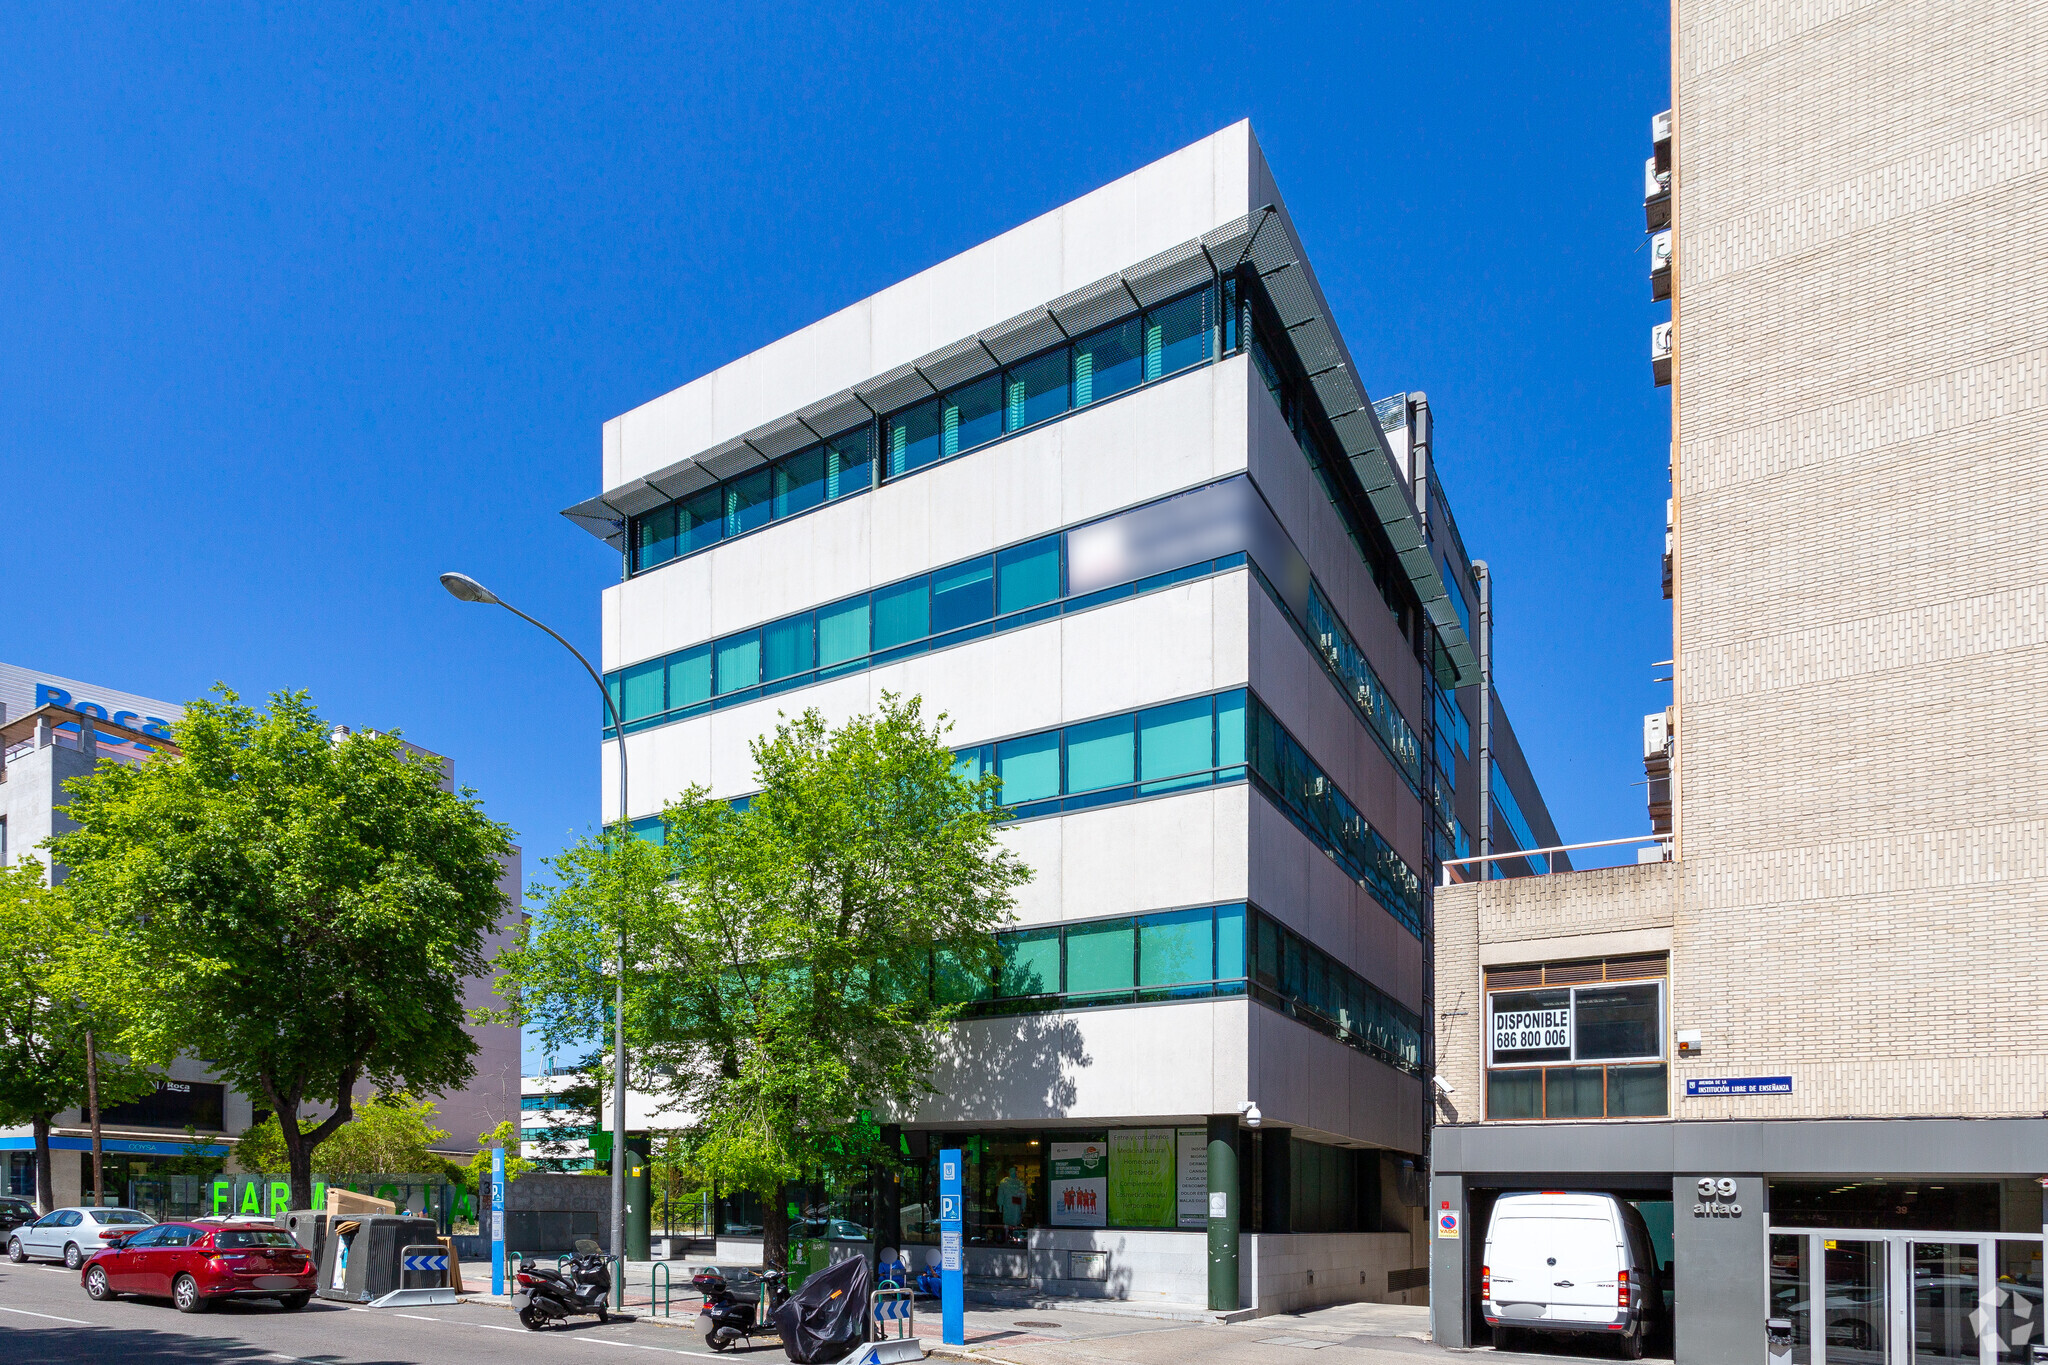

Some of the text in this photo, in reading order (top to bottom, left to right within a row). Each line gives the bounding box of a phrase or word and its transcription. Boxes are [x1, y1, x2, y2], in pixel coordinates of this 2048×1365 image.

[1497, 1011, 1568, 1030] DISPONIBLE
[1497, 1029, 1566, 1048] 686 800 006
[167, 1082, 190, 1091] Roca
[1698, 1085, 1730, 1093] INSTITUCIÓN
[1759, 1083, 1790, 1091] ENSEÑANZA
[1698, 1177, 1737, 1197] 39
[943, 1198, 953, 1218] P
[1693, 1201, 1742, 1213] altao
[1896, 1206, 1908, 1215] 39
